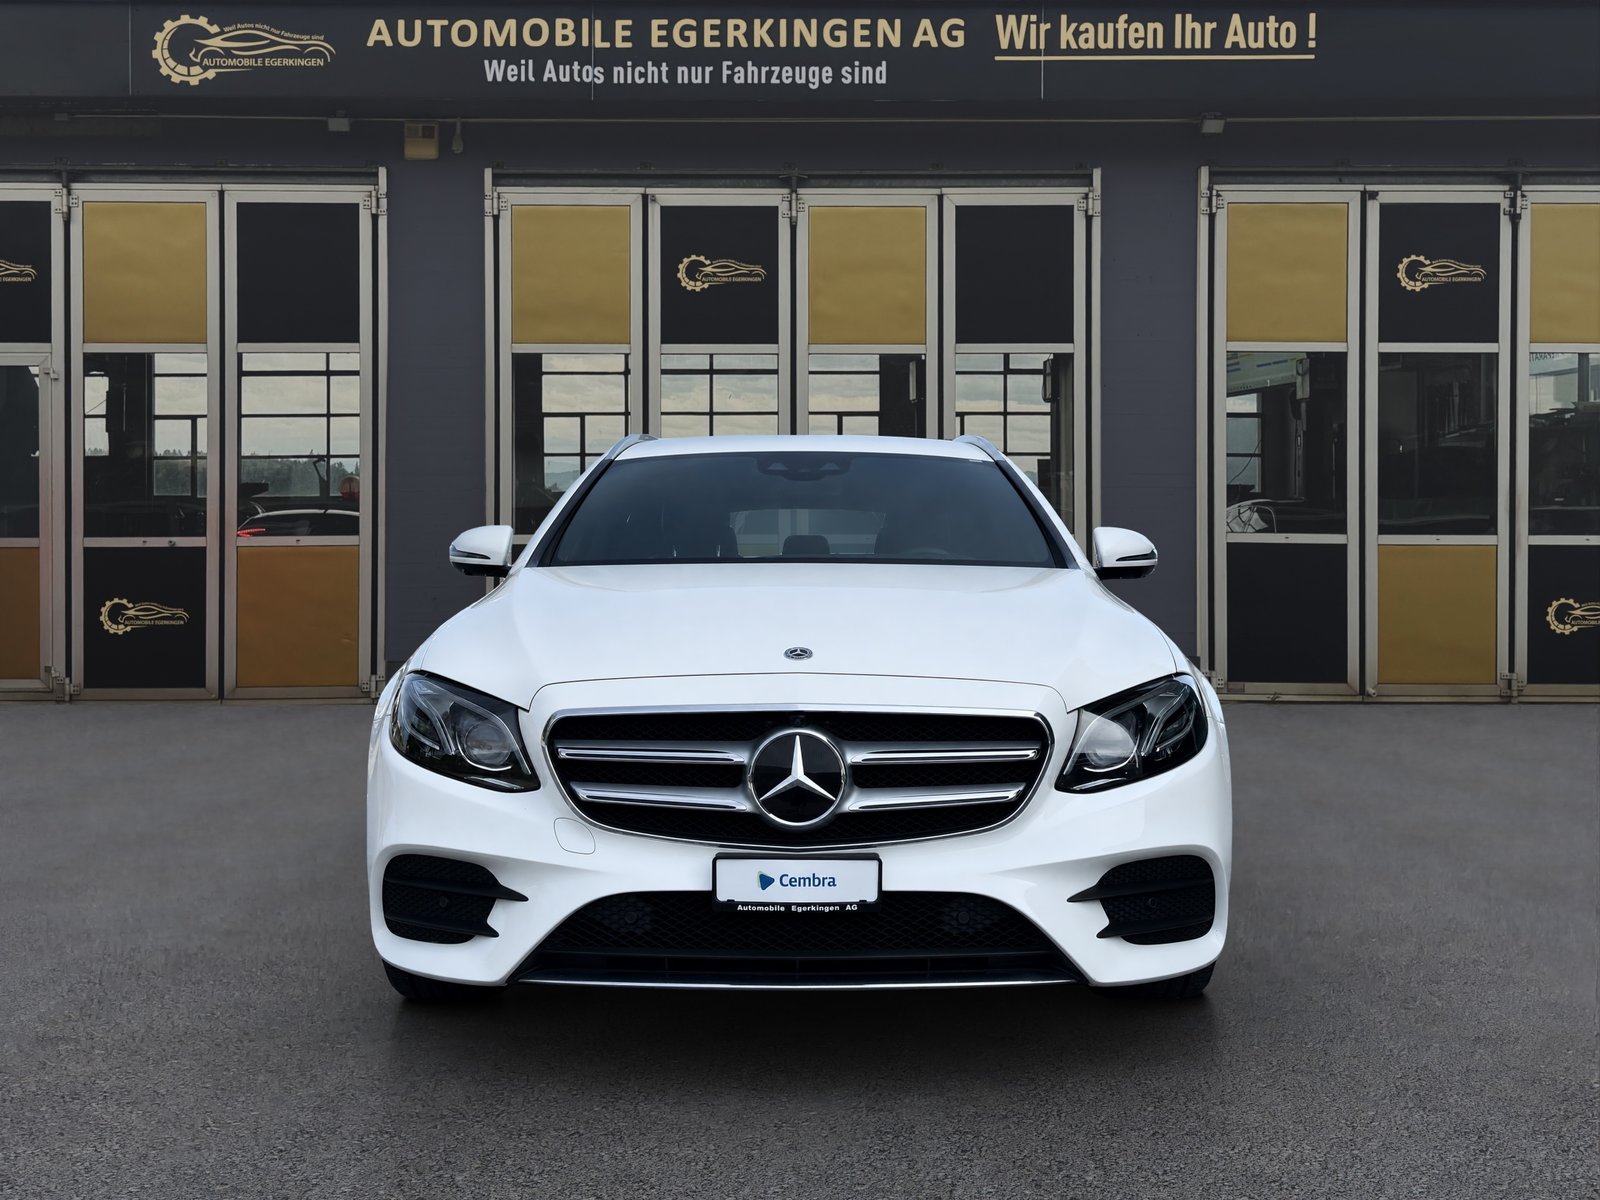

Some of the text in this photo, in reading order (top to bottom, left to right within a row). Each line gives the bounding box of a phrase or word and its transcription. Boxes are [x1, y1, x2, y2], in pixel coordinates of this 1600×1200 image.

[255, 23, 270, 31] nicht
[281, 31, 310, 40] Fahrzeuge
[366, 18, 965, 49] AUTOMOBILE EGERKINGEN AG
[995, 14, 1051, 49] Wir
[1060, 13, 1164, 50] kaufen
[1174, 13, 1218, 49] Ihr
[1224, 13, 1297, 49] Auto
[202, 58, 324, 67] AUTOMOBILE EGERKINGEN
[483, 59, 887, 89] Weil Autos nicht nur Fahrzeuge sind
[779, 873, 837, 888] Cembra
[737, 904, 785, 912] Automobile
[791, 904, 840, 912] Egerkingen
